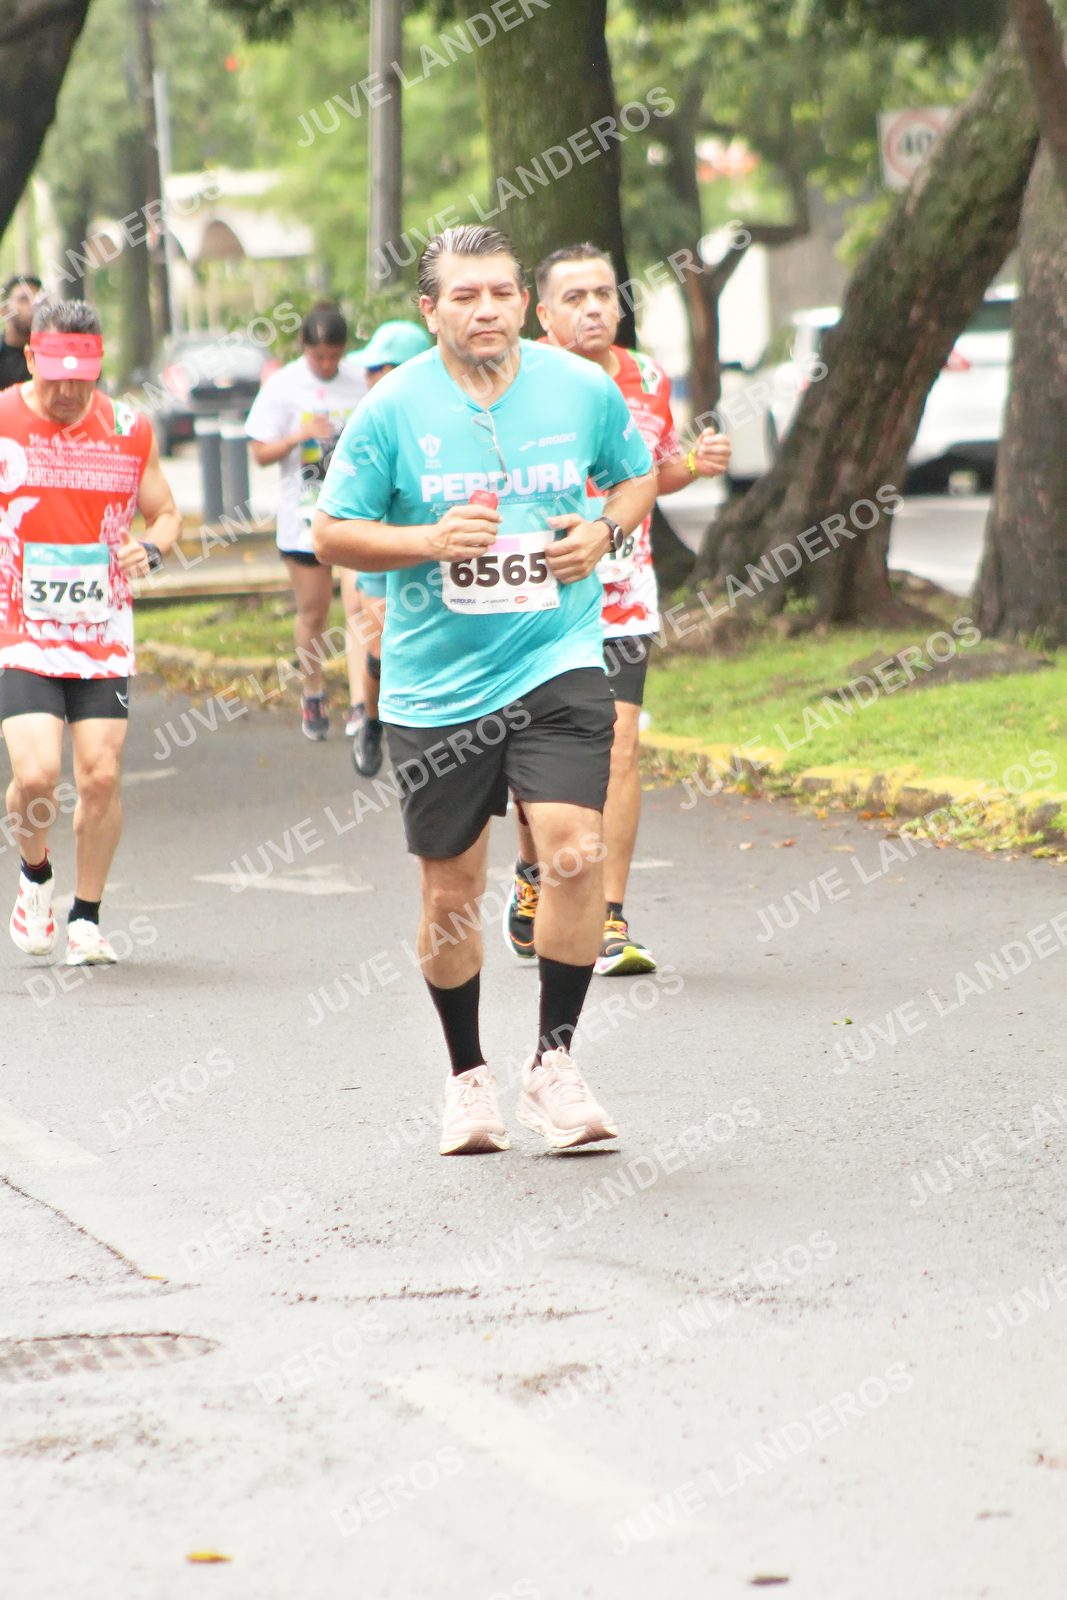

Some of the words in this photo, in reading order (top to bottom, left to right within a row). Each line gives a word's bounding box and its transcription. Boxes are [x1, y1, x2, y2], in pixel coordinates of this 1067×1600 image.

[420, 459, 581, 502] PERDURA
[450, 551, 548, 588] 6565
[29, 580, 104, 603] 3764
